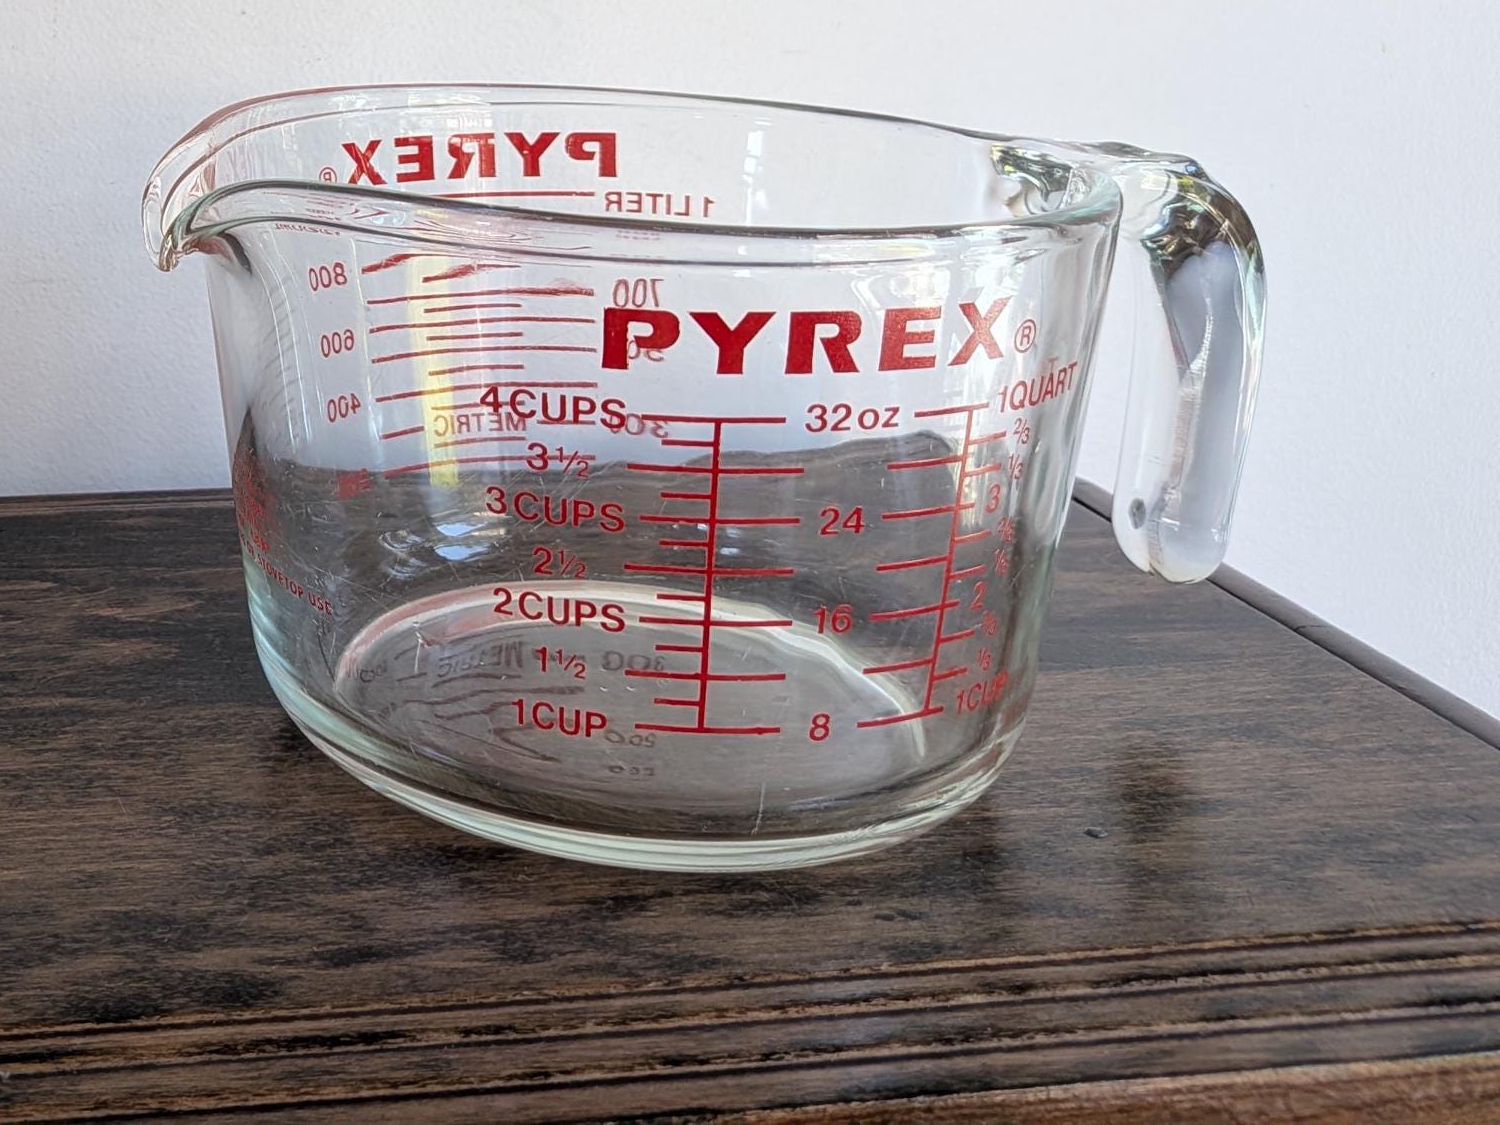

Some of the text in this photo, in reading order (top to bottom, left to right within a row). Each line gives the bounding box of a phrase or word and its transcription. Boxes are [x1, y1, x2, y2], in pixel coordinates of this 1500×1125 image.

[985, 483, 1001, 513] 3
[819, 506, 865, 536] 24
[971, 581, 987, 610] 2
[813, 604, 853, 634] 16
[808, 713, 831, 742] 8
